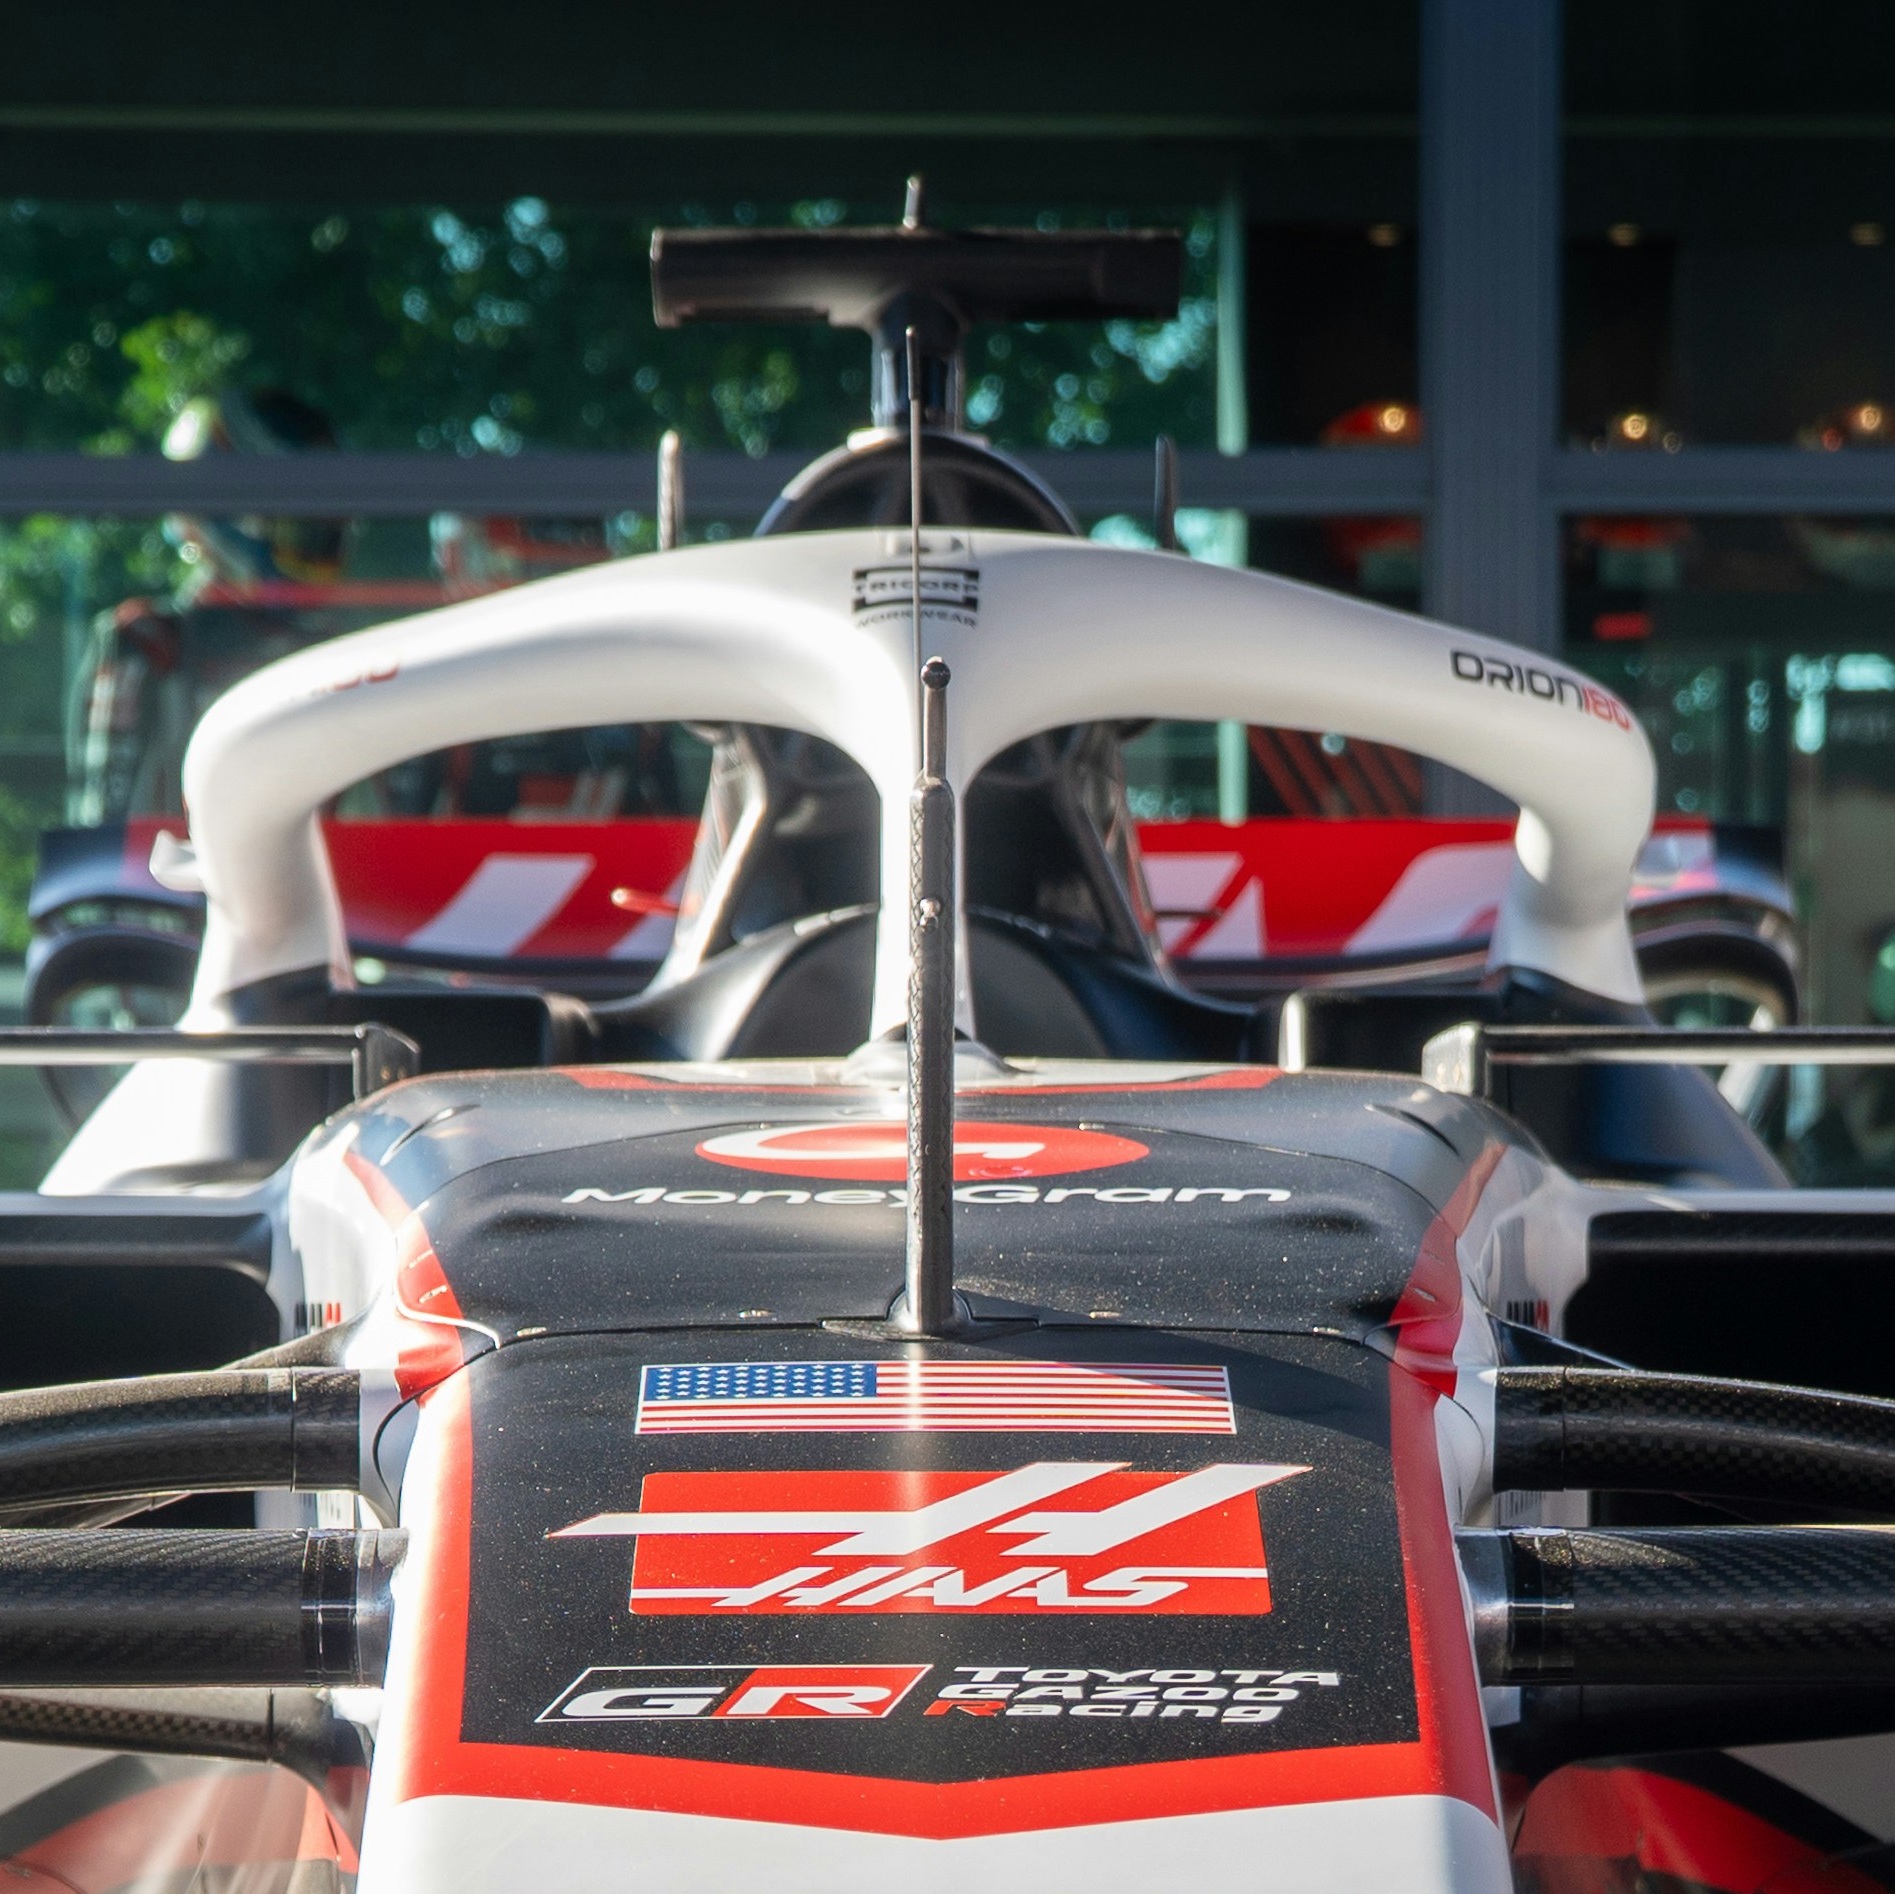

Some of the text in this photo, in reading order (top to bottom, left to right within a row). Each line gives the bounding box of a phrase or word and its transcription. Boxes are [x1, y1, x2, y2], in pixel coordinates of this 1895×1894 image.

[1450, 649, 1633, 732] ORION180
[712, 1567, 1190, 1608] HAAS
[954, 1665, 1341, 1686] TOYOTA
[560, 1685, 891, 1717] GR
[937, 1683, 1300, 1700] GAZOO
[923, 1699, 1284, 1724] Racing
